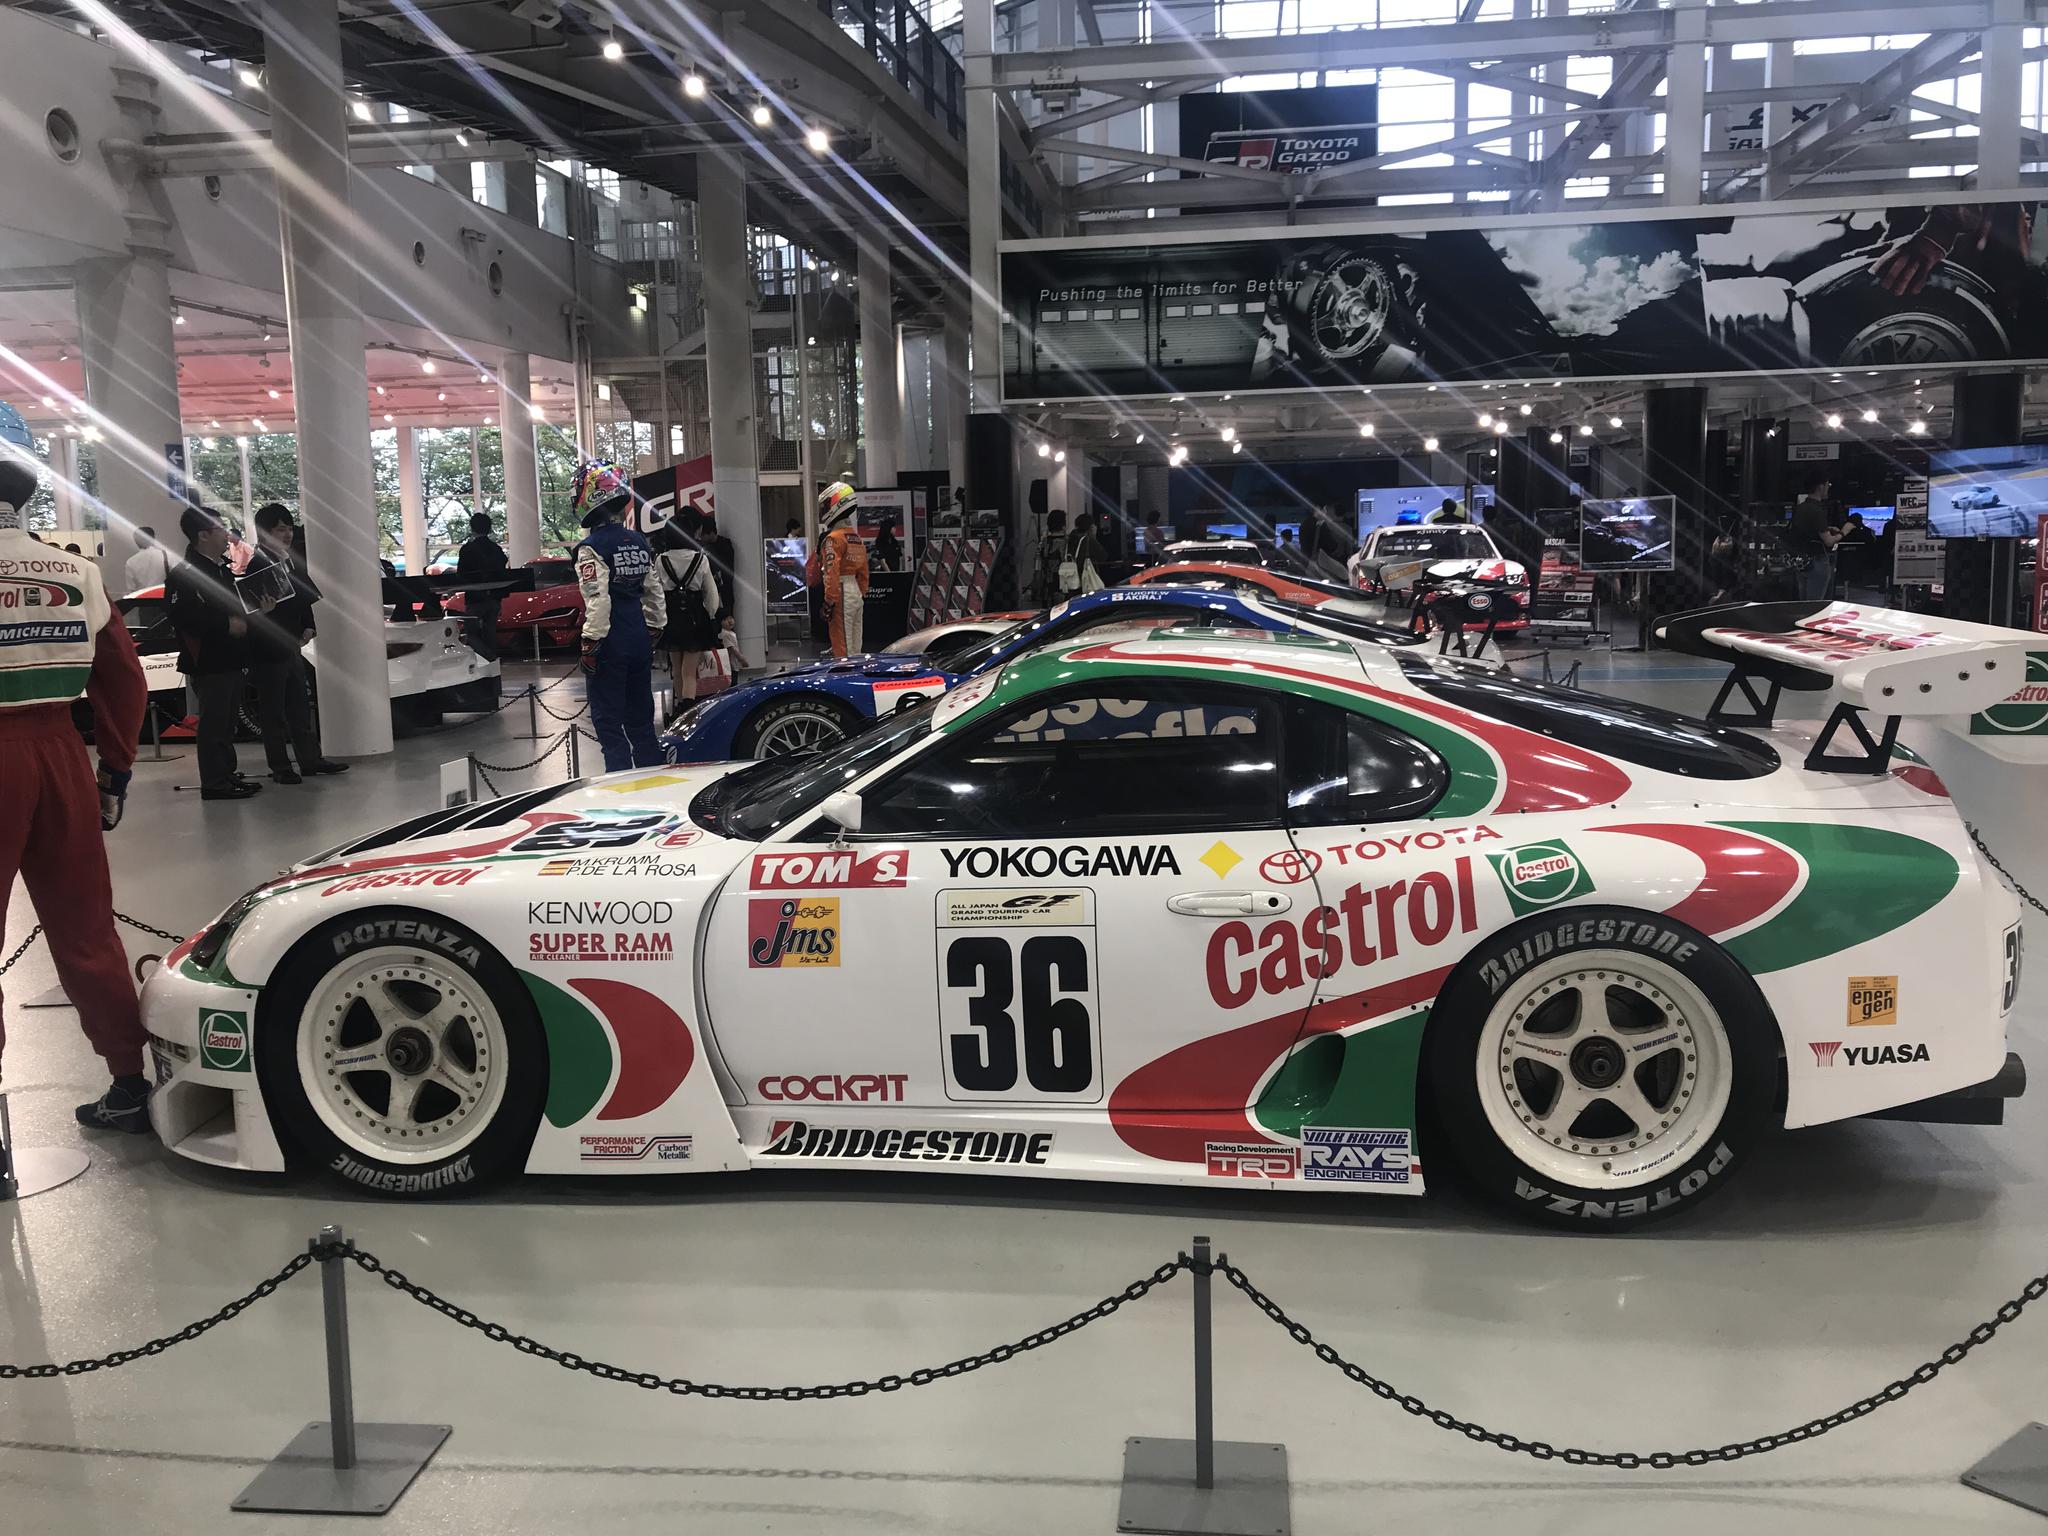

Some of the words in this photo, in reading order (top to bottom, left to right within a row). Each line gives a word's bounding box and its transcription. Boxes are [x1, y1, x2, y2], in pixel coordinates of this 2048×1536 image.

[1280, 137, 1359, 151] TOYOTA
[1277, 150, 1350, 164] GAZOO
[1039, 288, 1107, 302] Pushing
[1116, 286, 1143, 299] the
[1151, 284, 1201, 297] limits
[1211, 281, 1238, 294] for
[1246, 278, 1304, 293] Better
[20, 560, 80, 576] TOYOTA
[612, 549, 650, 567] ESSO
[0, 625, 82, 640] MICHELIN
[146, 663, 174, 671] GAZOO
[754, 702, 841, 732] POTENZA
[1328, 824, 1504, 866] TOYOTA
[572, 855, 661, 866] M.KRUMM
[613, 866, 638, 876] LA
[644, 864, 696, 876] ROSA
[940, 845, 1182, 878] YOKOGAWA
[1515, 855, 1570, 881] Castrol
[528, 900, 673, 925] KENWOOD
[332, 920, 481, 968] POTENZA
[530, 933, 606, 953] SUPER
[615, 933, 674, 953] RAM
[1206, 856, 1479, 1010] Castrol
[1478, 919, 1701, 996] BRIDGESTONE
[946, 935, 1093, 1093] 36
[207, 1033, 243, 1049] Castrol
[1843, 1043, 1930, 1066] YUASA
[758, 1074, 908, 1101] COCKPIT
[759, 1120, 1053, 1165] BRIDGESTONE
[1207, 1144, 1237, 1152] Racing
[1237, 1145, 1295, 1154] Development
[1304, 1131, 1344, 1143] VOLK
[1346, 1132, 1408, 1144] RACING
[1211, 1157, 1290, 1178] TRD
[1304, 1146, 1409, 1170] RAYS
[330, 1153, 475, 1192] BRIDGESTONE
[1305, 1169, 1409, 1181] ENGINEERING
[1515, 1140, 1734, 1218] POTENZA
